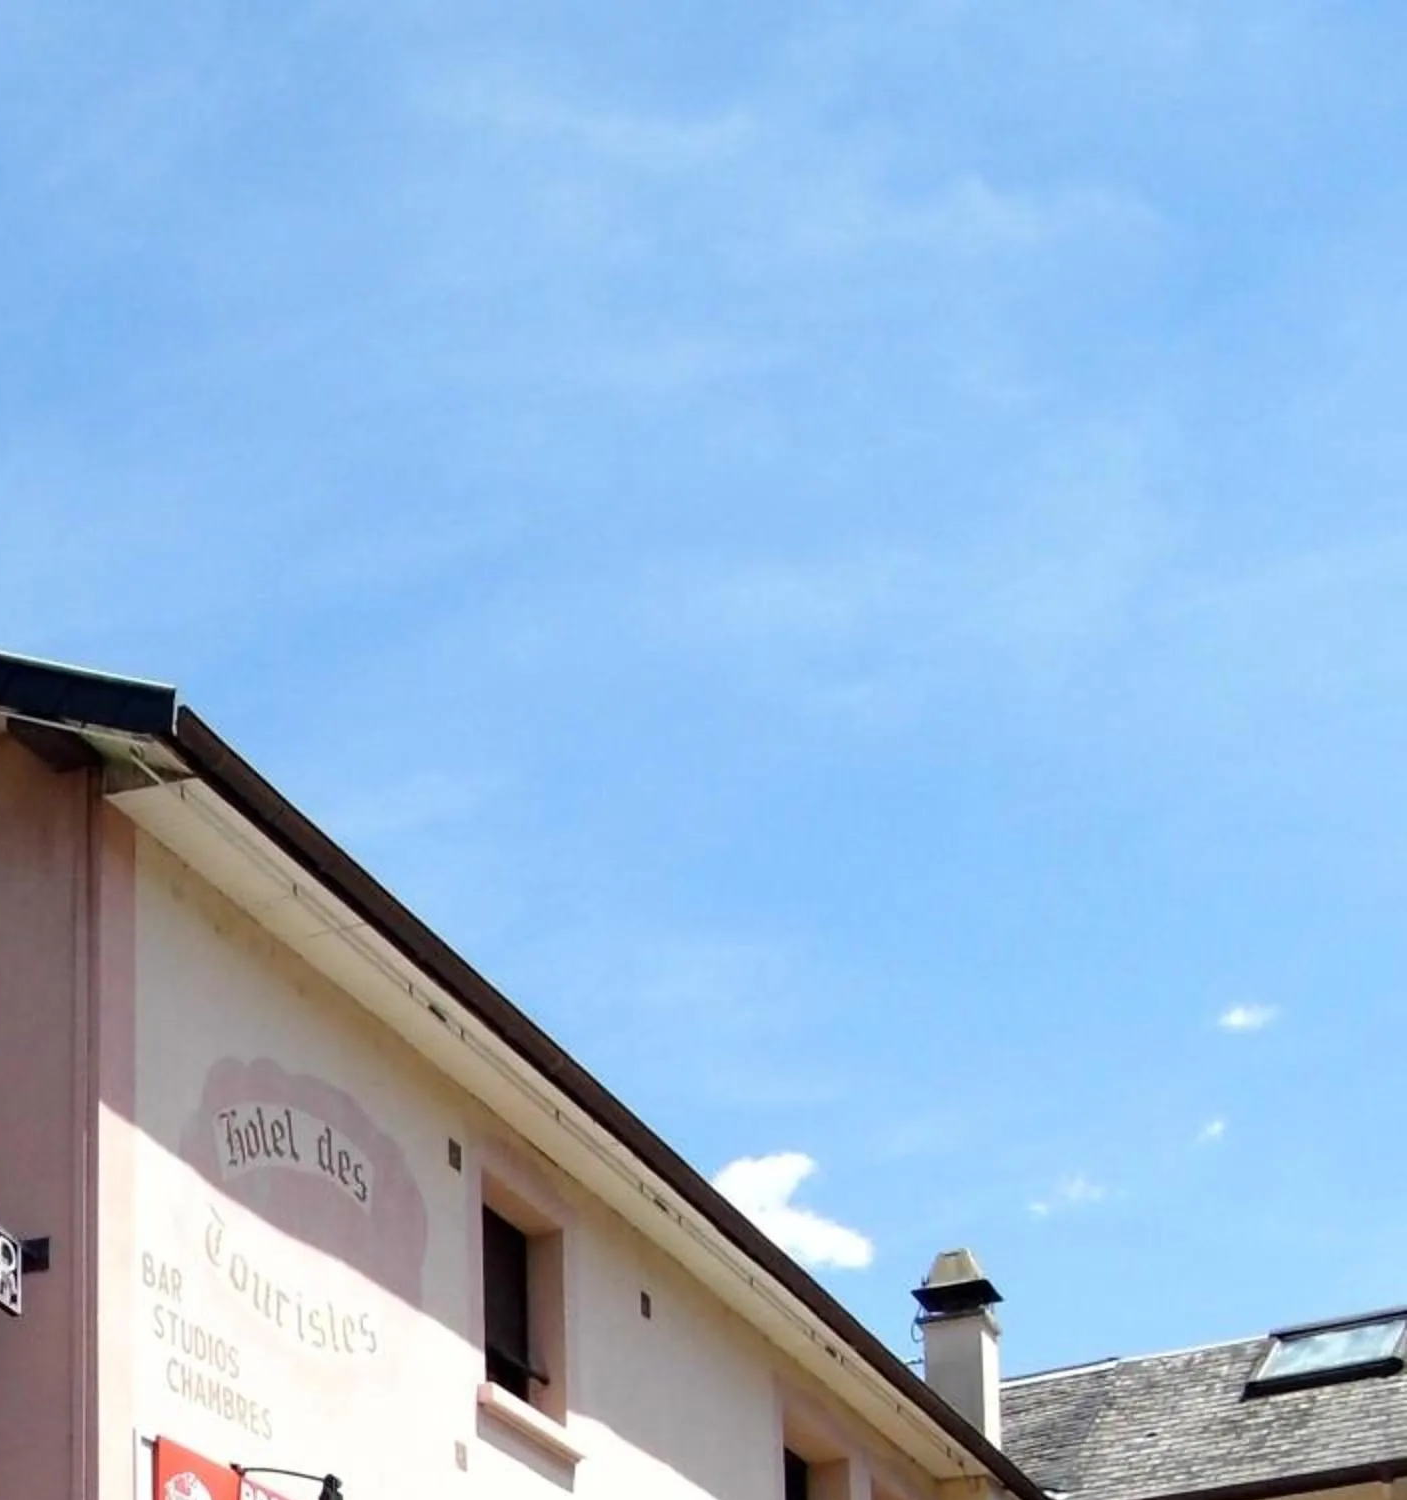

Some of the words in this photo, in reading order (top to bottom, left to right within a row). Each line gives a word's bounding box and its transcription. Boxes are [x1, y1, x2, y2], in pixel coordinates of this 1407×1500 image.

[317, 1127, 368, 1202] des
[141, 1251, 183, 1303] BAR
[153, 1305, 241, 1380] STUDIOS
[166, 1357, 274, 1440] CHAMBRES
